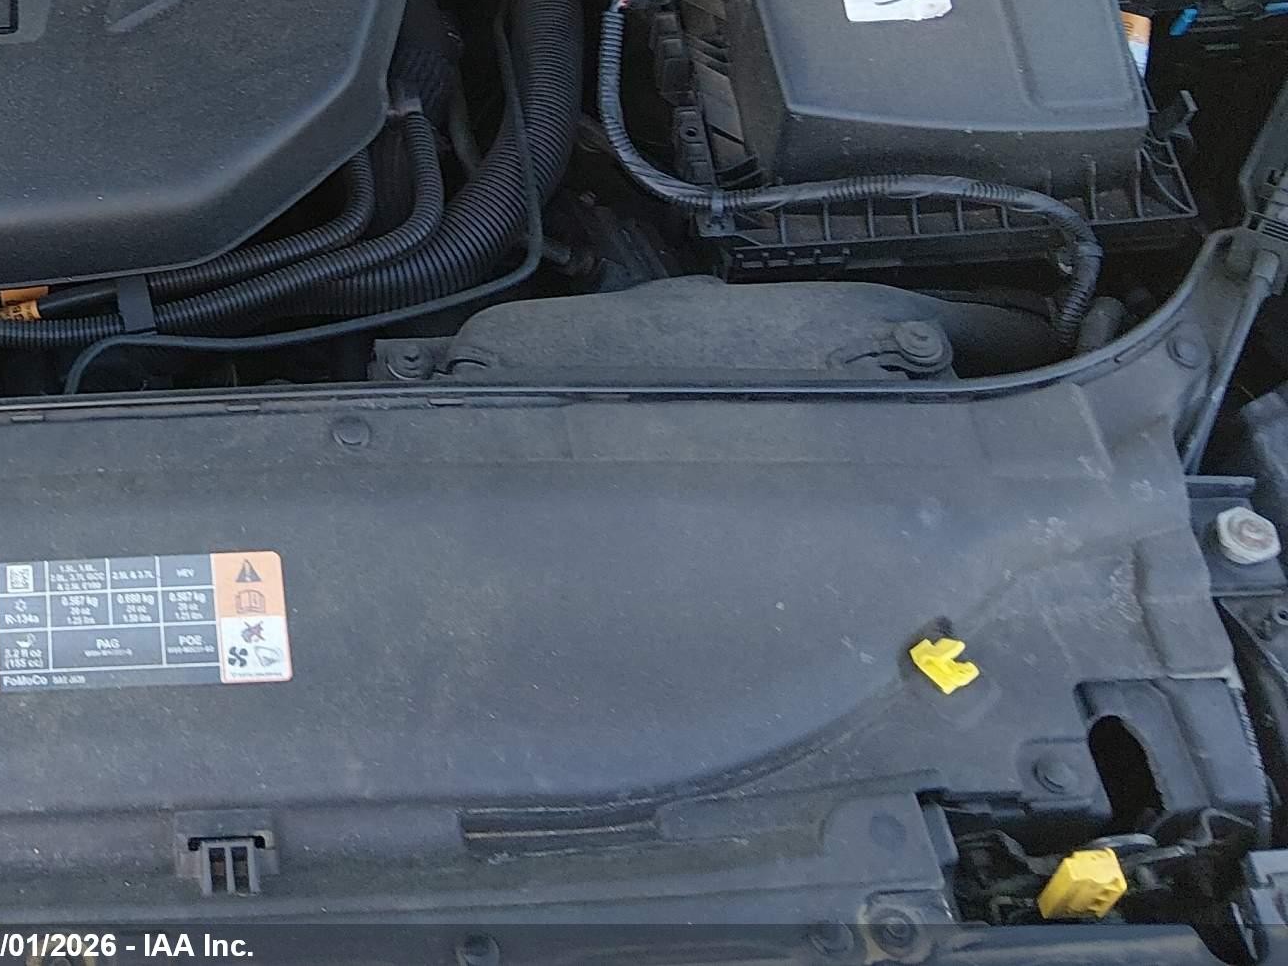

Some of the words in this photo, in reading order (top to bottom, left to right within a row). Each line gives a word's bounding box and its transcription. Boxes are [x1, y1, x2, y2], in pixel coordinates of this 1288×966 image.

[85, 595, 98, 608] kg
[142, 593, 154, 605] kg
[193, 591, 206, 604] kg
[5, 614, 40, 625] R-134a
[95, 638, 121, 649] PAG
[178, 634, 203, 646] POE
[29, 649, 42, 658] oz
[3, 675, 48, 687] FoMoCo
